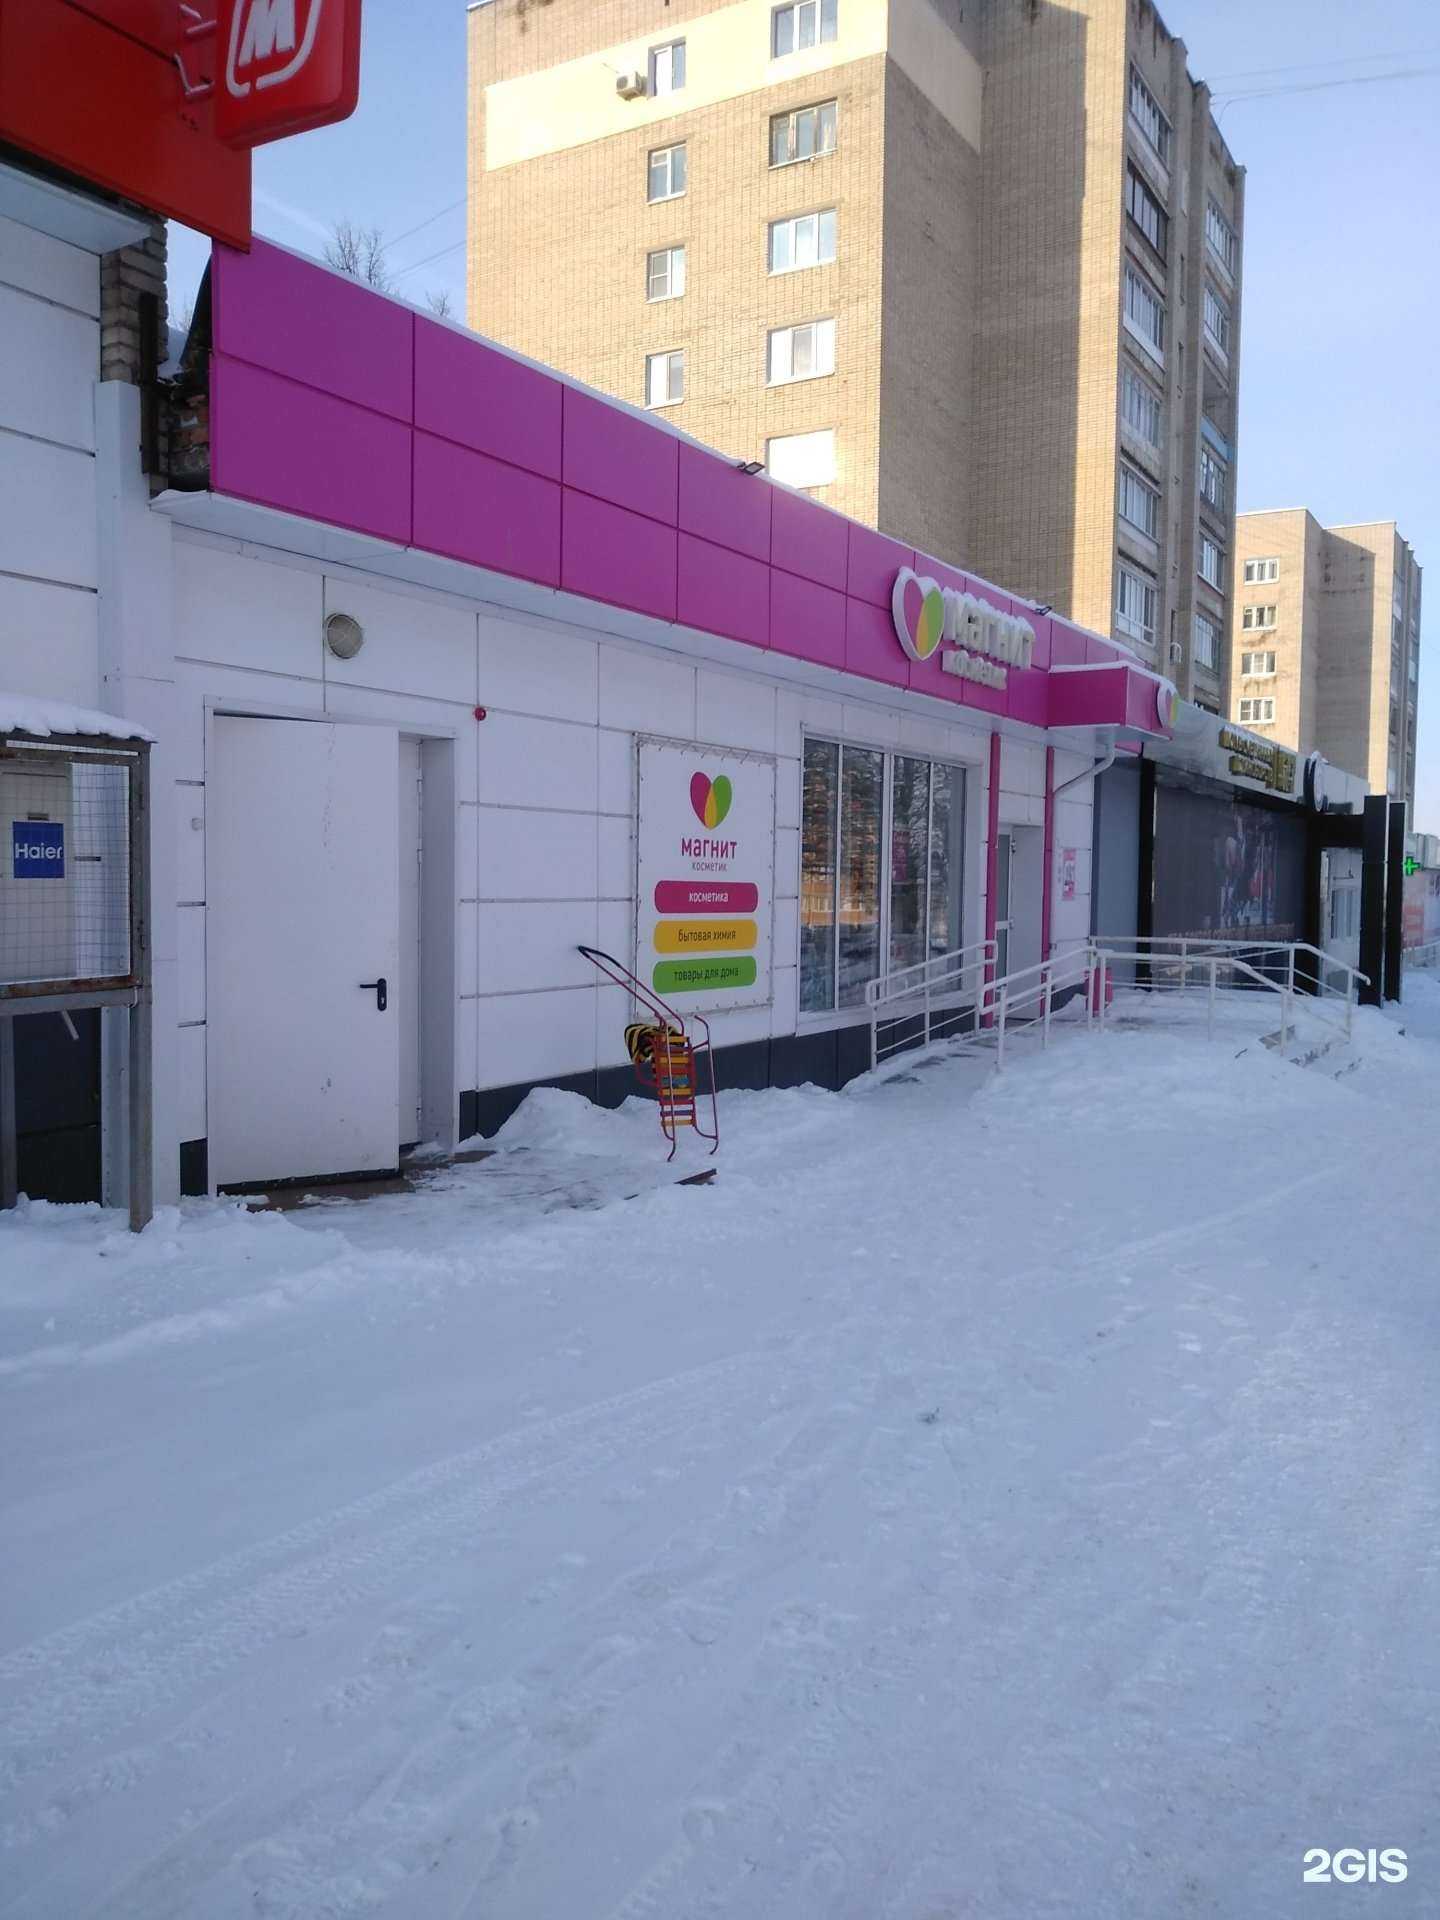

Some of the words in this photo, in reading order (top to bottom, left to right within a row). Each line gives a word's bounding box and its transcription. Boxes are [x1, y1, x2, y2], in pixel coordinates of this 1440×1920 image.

[15, 843, 62, 859] Haier
[681, 837, 737, 859] магнит
[692, 861, 727, 872] косметик
[689, 892, 729, 903] косметика
[678, 928, 712, 942] бытовая
[713, 930, 736, 941] химия
[674, 969, 703, 983] товары
[704, 968, 719, 980] для
[720, 967, 739, 980] дома
